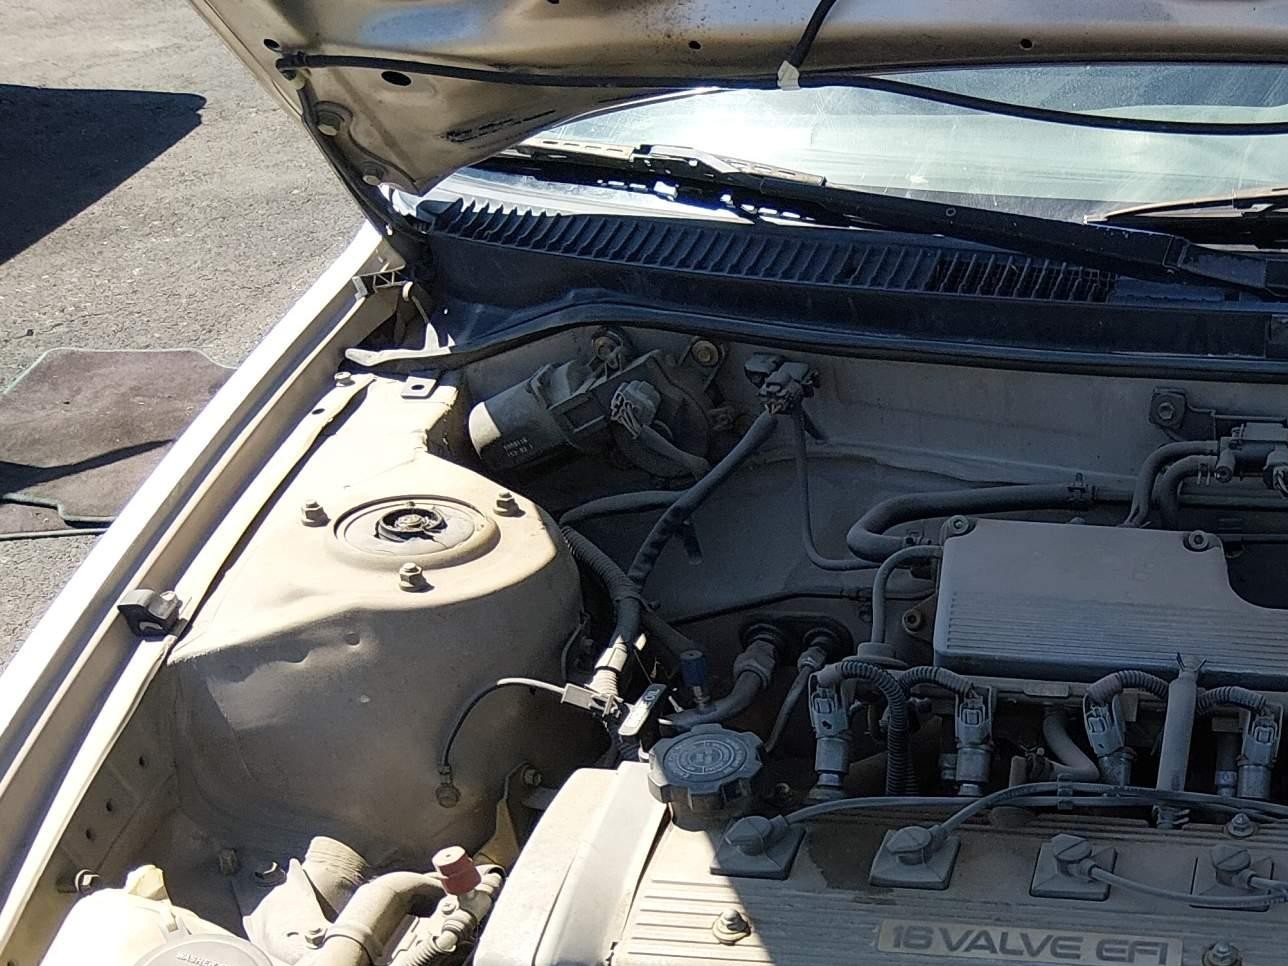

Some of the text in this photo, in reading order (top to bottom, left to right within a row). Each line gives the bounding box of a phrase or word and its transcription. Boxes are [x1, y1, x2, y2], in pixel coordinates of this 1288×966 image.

[892, 926, 1169, 966] 16 VALVE EFI
